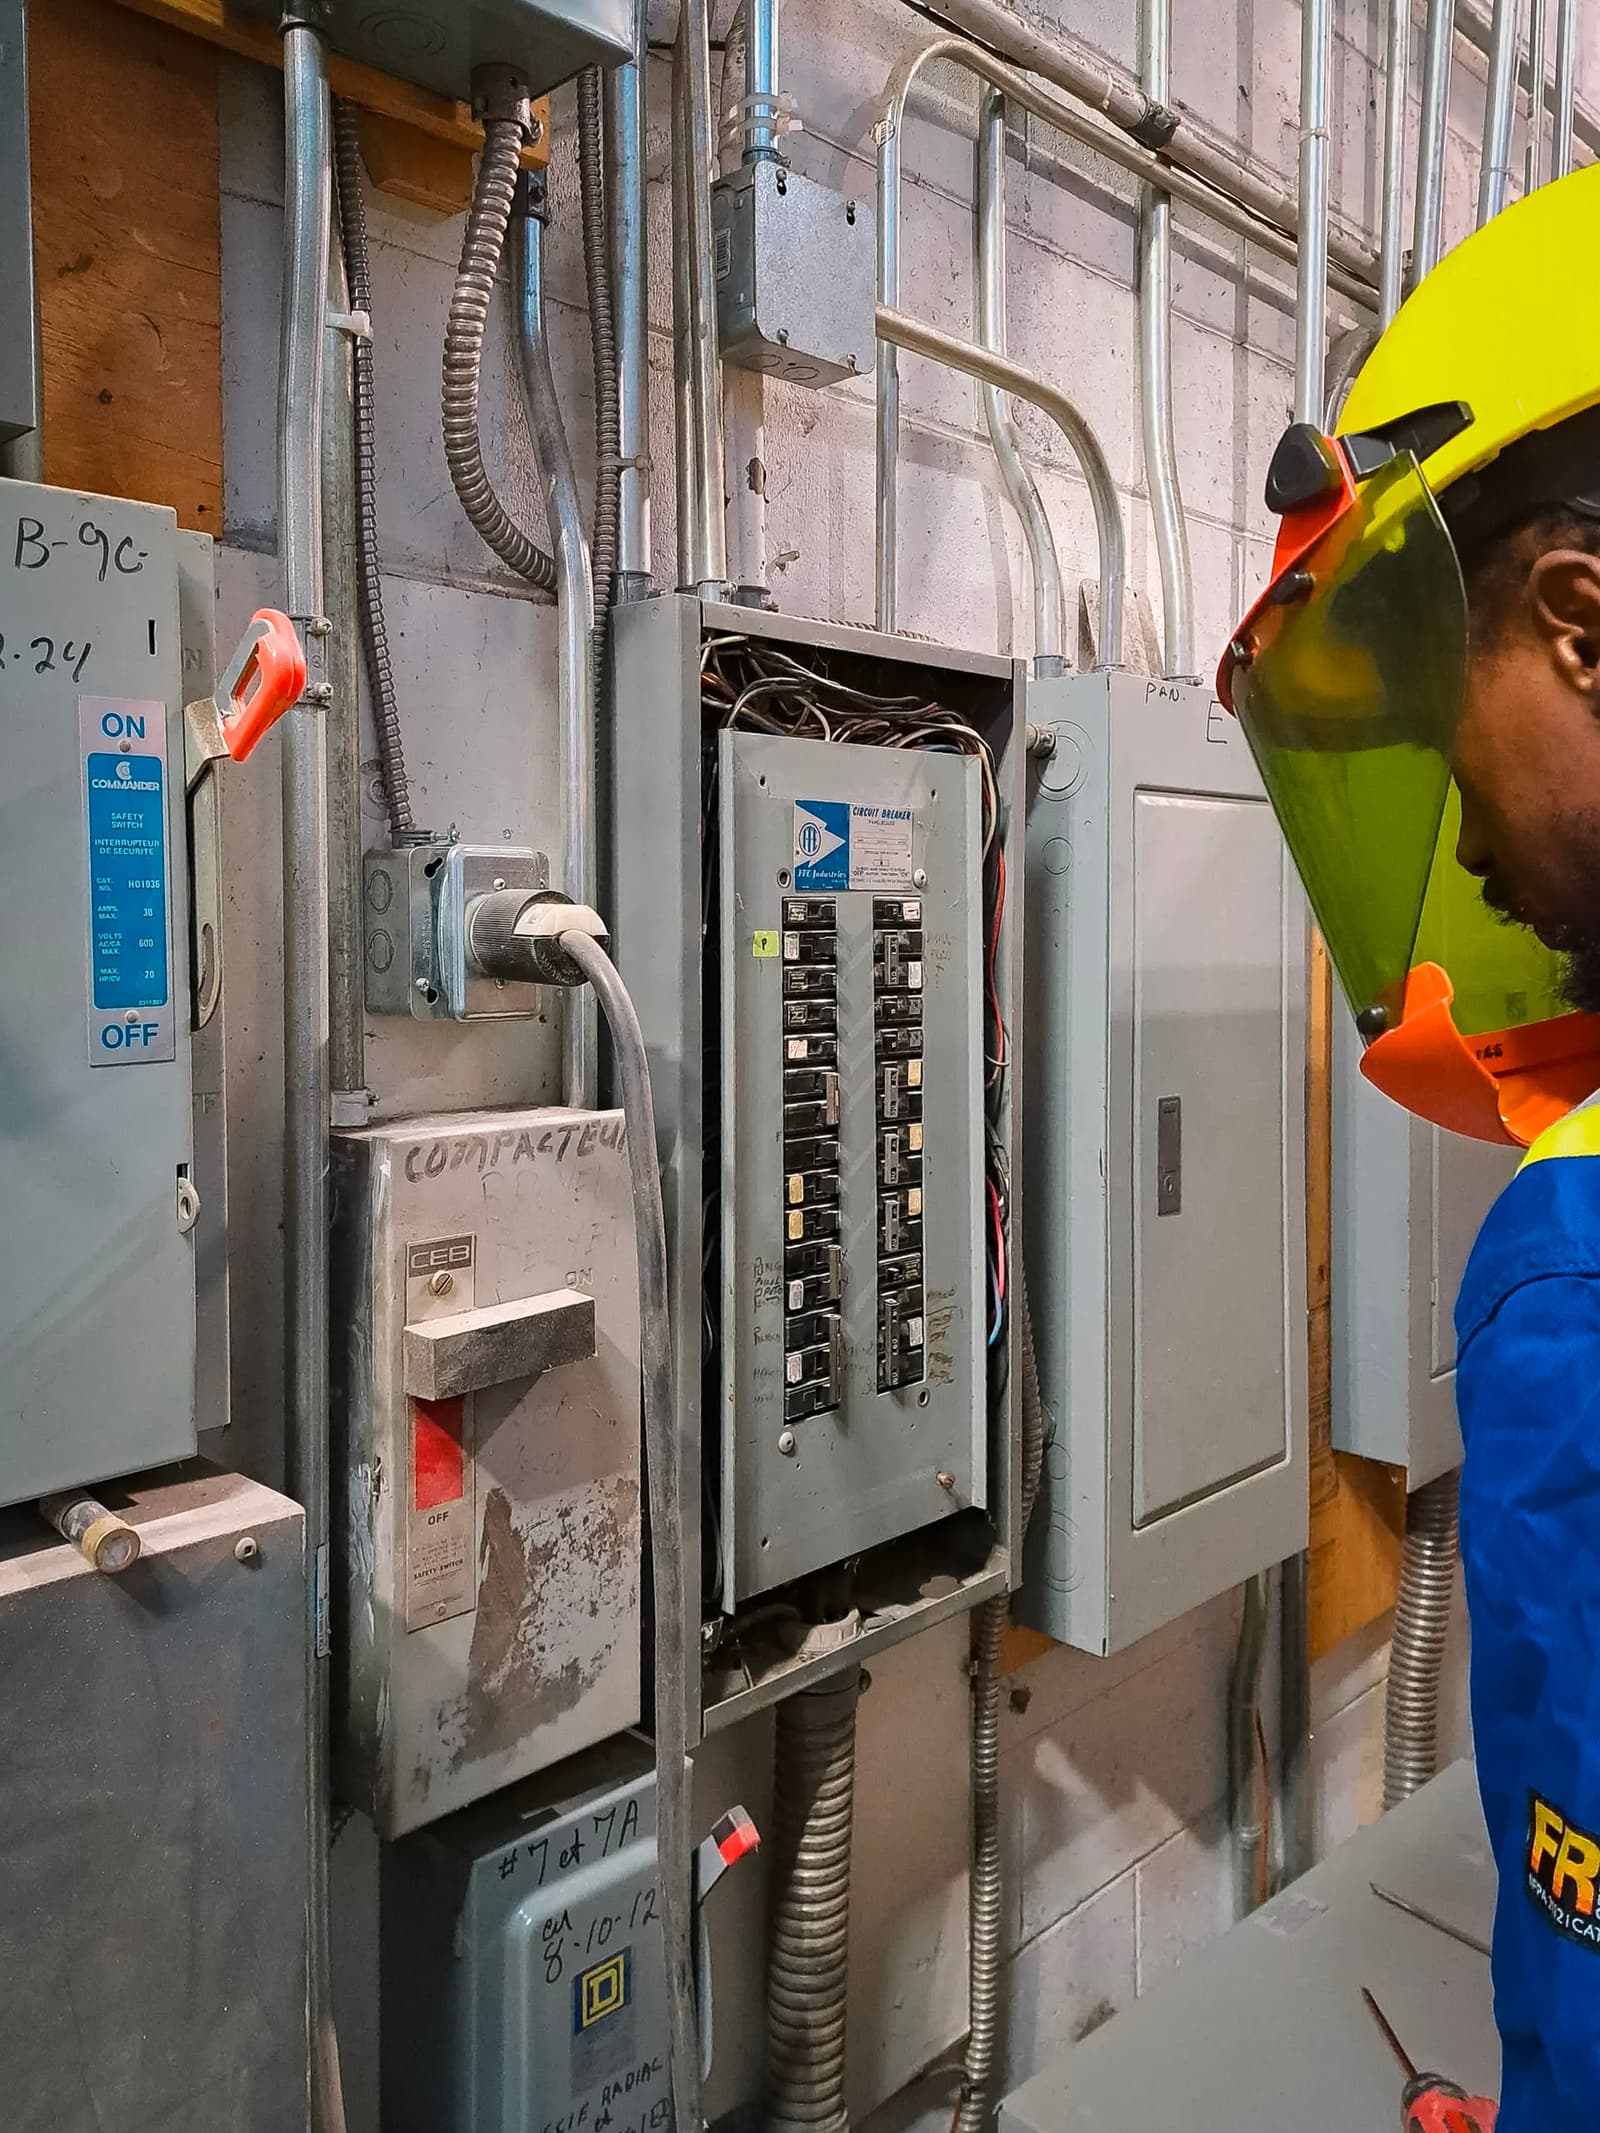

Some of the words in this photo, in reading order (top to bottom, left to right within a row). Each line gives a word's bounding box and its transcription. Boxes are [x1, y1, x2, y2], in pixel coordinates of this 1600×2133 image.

[101, 712, 146, 740] ON
[1207, 700, 1228, 744] E
[92, 778, 160, 791] COMMANDER
[111, 812, 144, 821] SAFETY
[852, 806, 879, 818] CIRCUIT
[881, 808, 912, 820] BREAKER
[111, 821, 143, 829] SWITCH
[95, 839, 160, 848] INTERRUPTEUR
[143, 908, 154, 917] 30
[101, 1022, 159, 1050] OFF
[411, 1245, 470, 1269] CEB
[428, 1511, 449, 1526] OFF
[559, 1827, 585, 1868] et
[1531, 1799, 1600, 1916] FR
